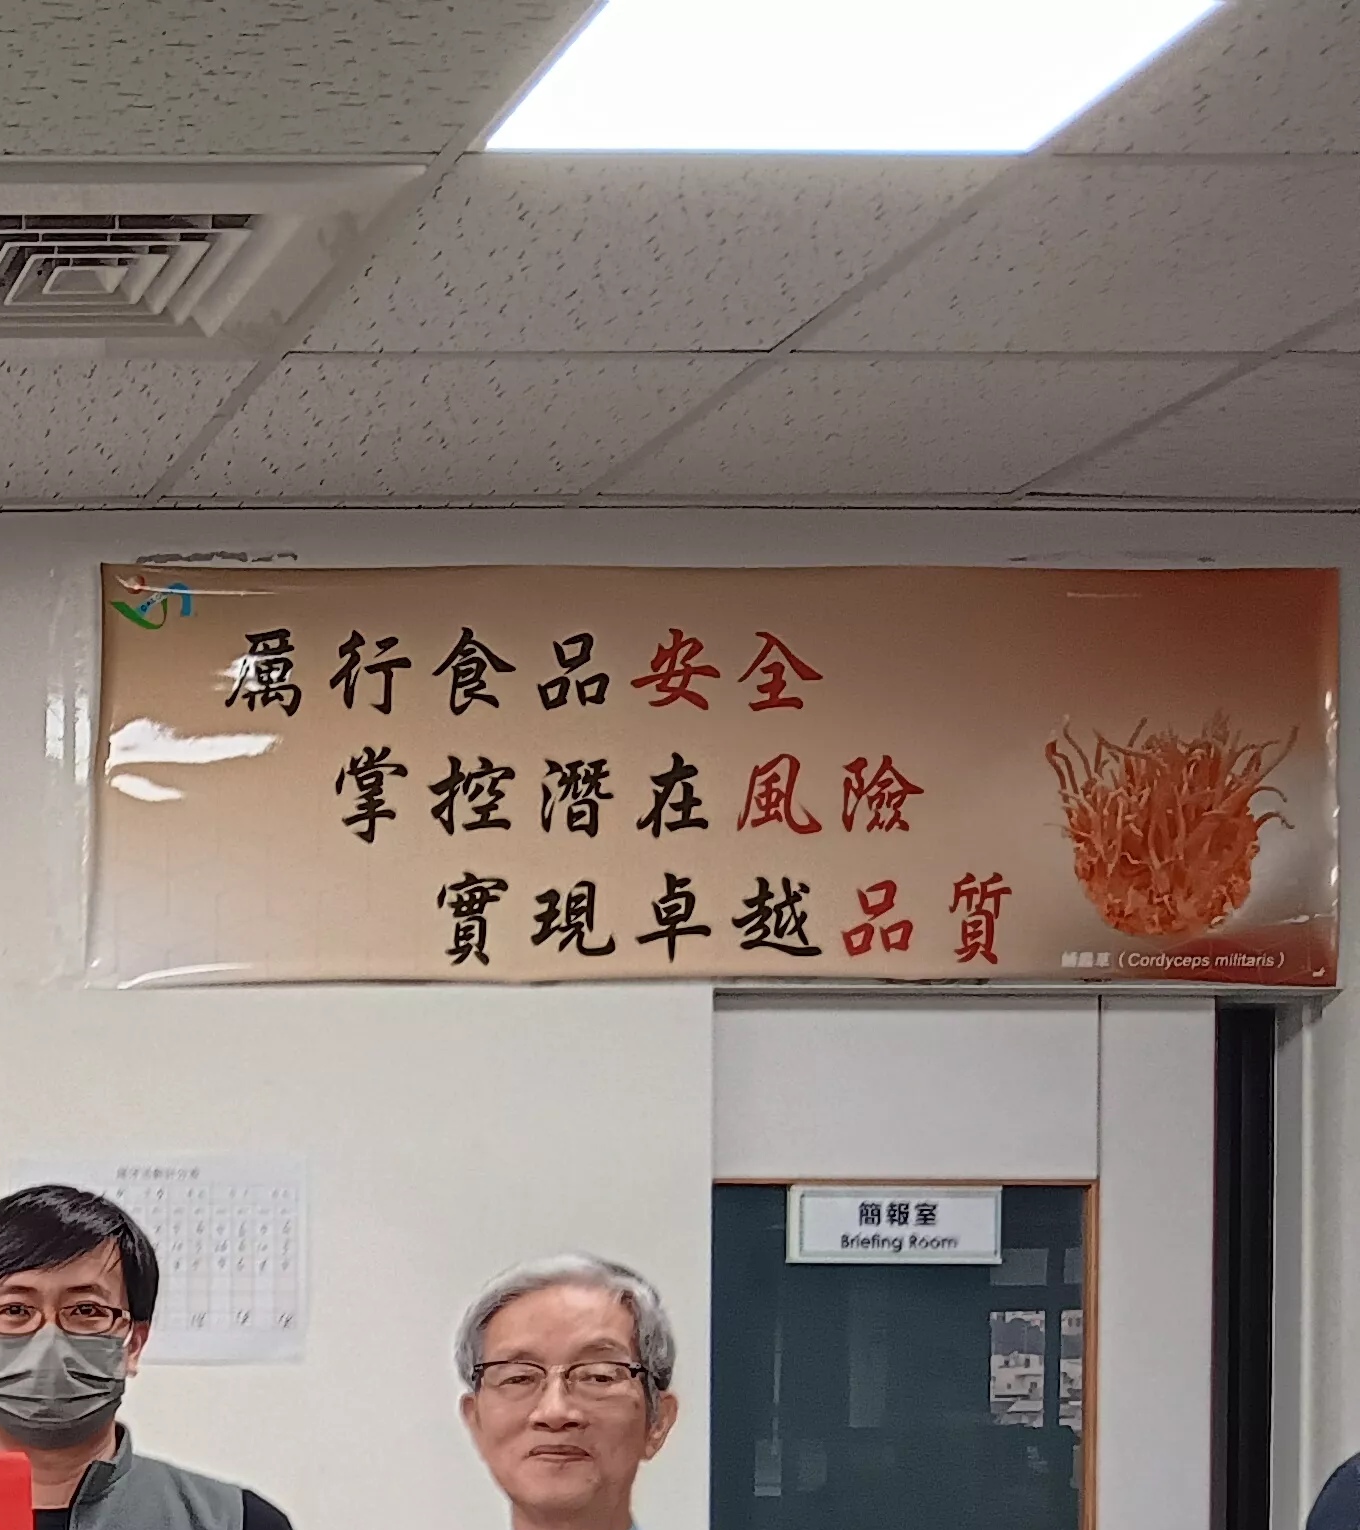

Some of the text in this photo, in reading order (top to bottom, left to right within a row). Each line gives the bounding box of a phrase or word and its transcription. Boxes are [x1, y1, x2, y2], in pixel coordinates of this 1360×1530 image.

[225, 626, 824, 717] 厲行食品安全
[335, 746, 923, 843] 掌控潛在風險
[437, 871, 1014, 966] 實現卓越品質
[841, 1233, 960, 1252] Briefing Room
[858, 1201, 938, 1227] 簡報室
